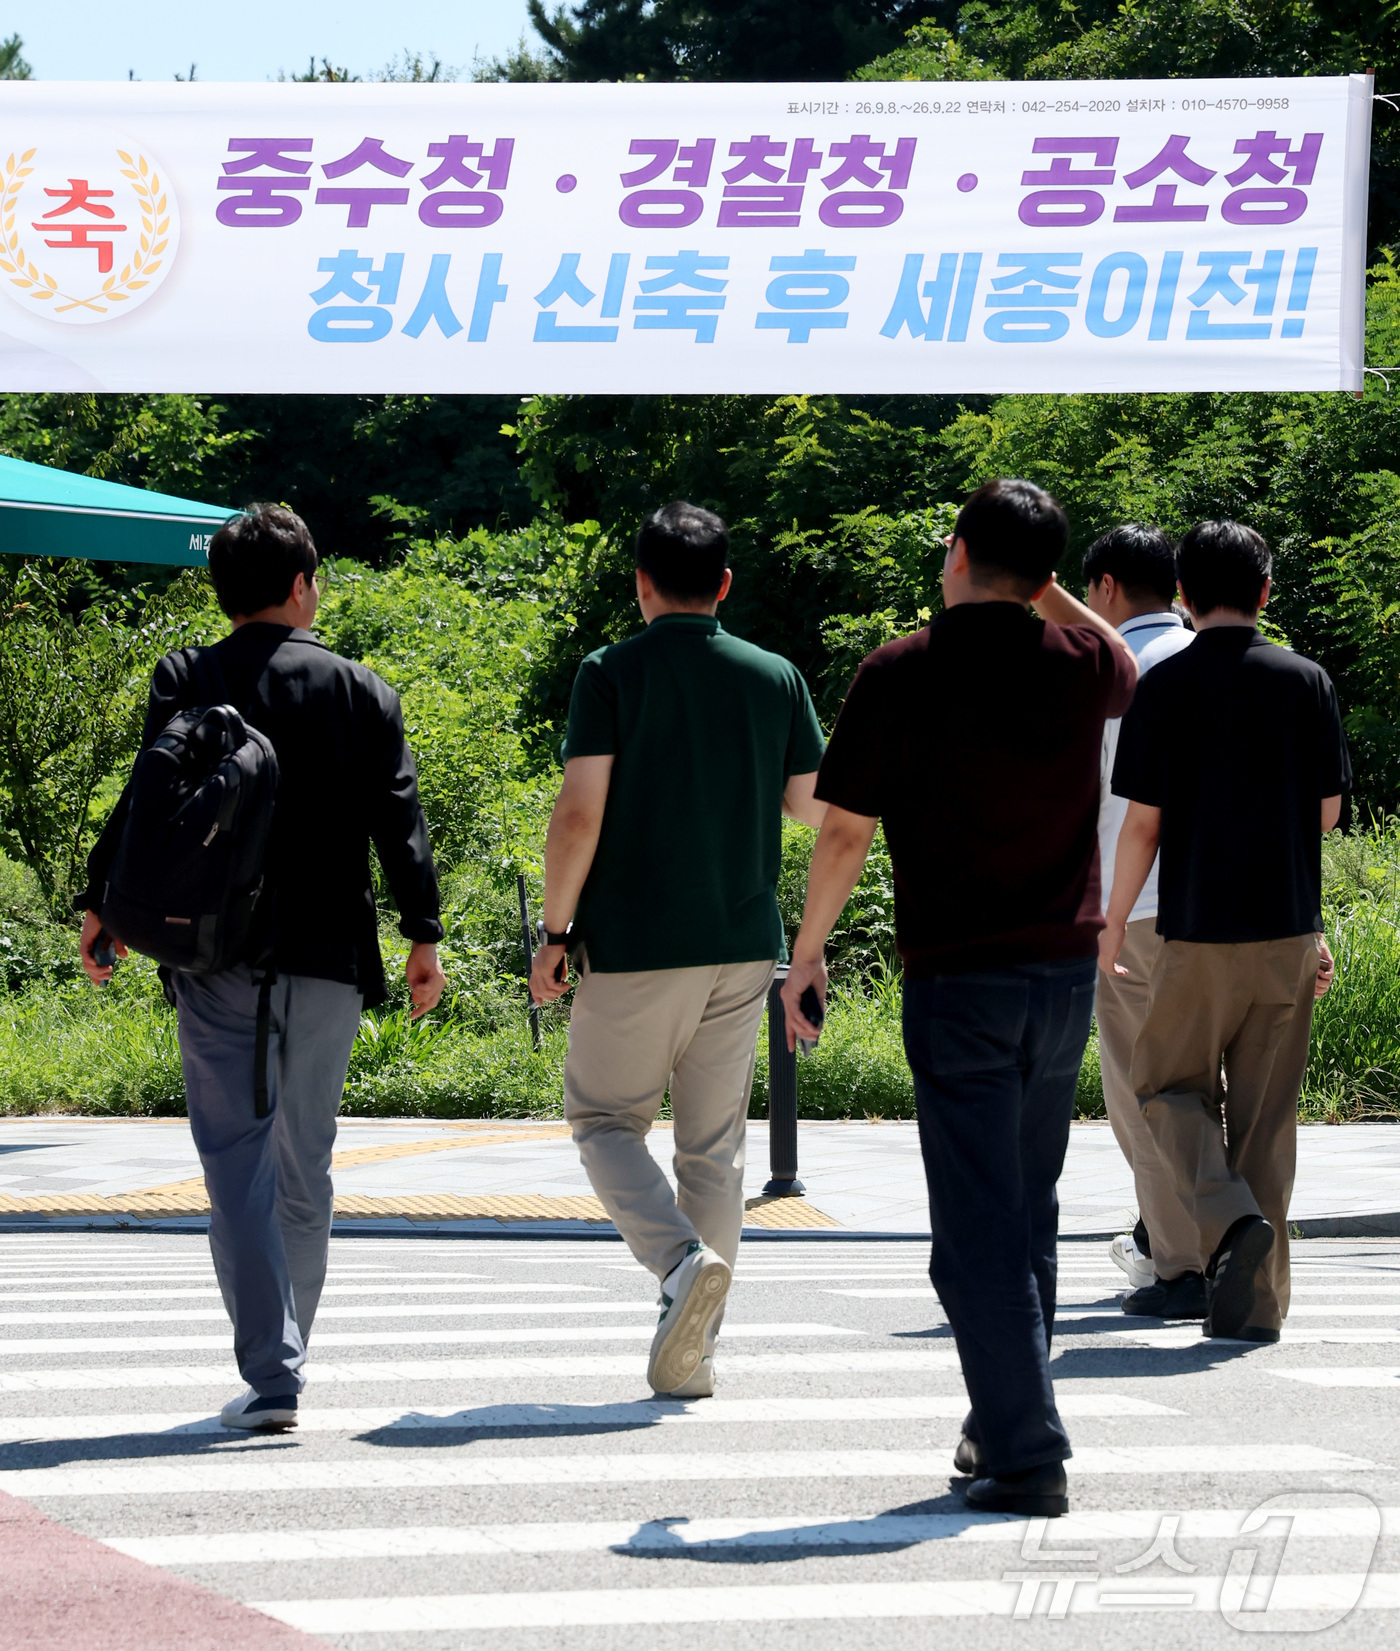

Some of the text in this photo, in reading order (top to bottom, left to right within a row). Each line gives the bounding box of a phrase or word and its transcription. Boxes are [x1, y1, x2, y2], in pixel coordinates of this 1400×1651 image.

[787, 101, 840, 115] 표시기간
[966, 100, 1006, 114] 연락처
[1021, 100, 1121, 113] 042-254-2020
[1126, 98, 1166, 113] 설치자
[1181, 97, 1290, 111] 010-4570-9958
[31, 178, 128, 273] 축
[215, 135, 515, 228] 중수청
[618, 134, 918, 229] 경찰청
[1017, 130, 1324, 227] 공소청
[307, 247, 1319, 344] 청사 신축 후 세종이전!
